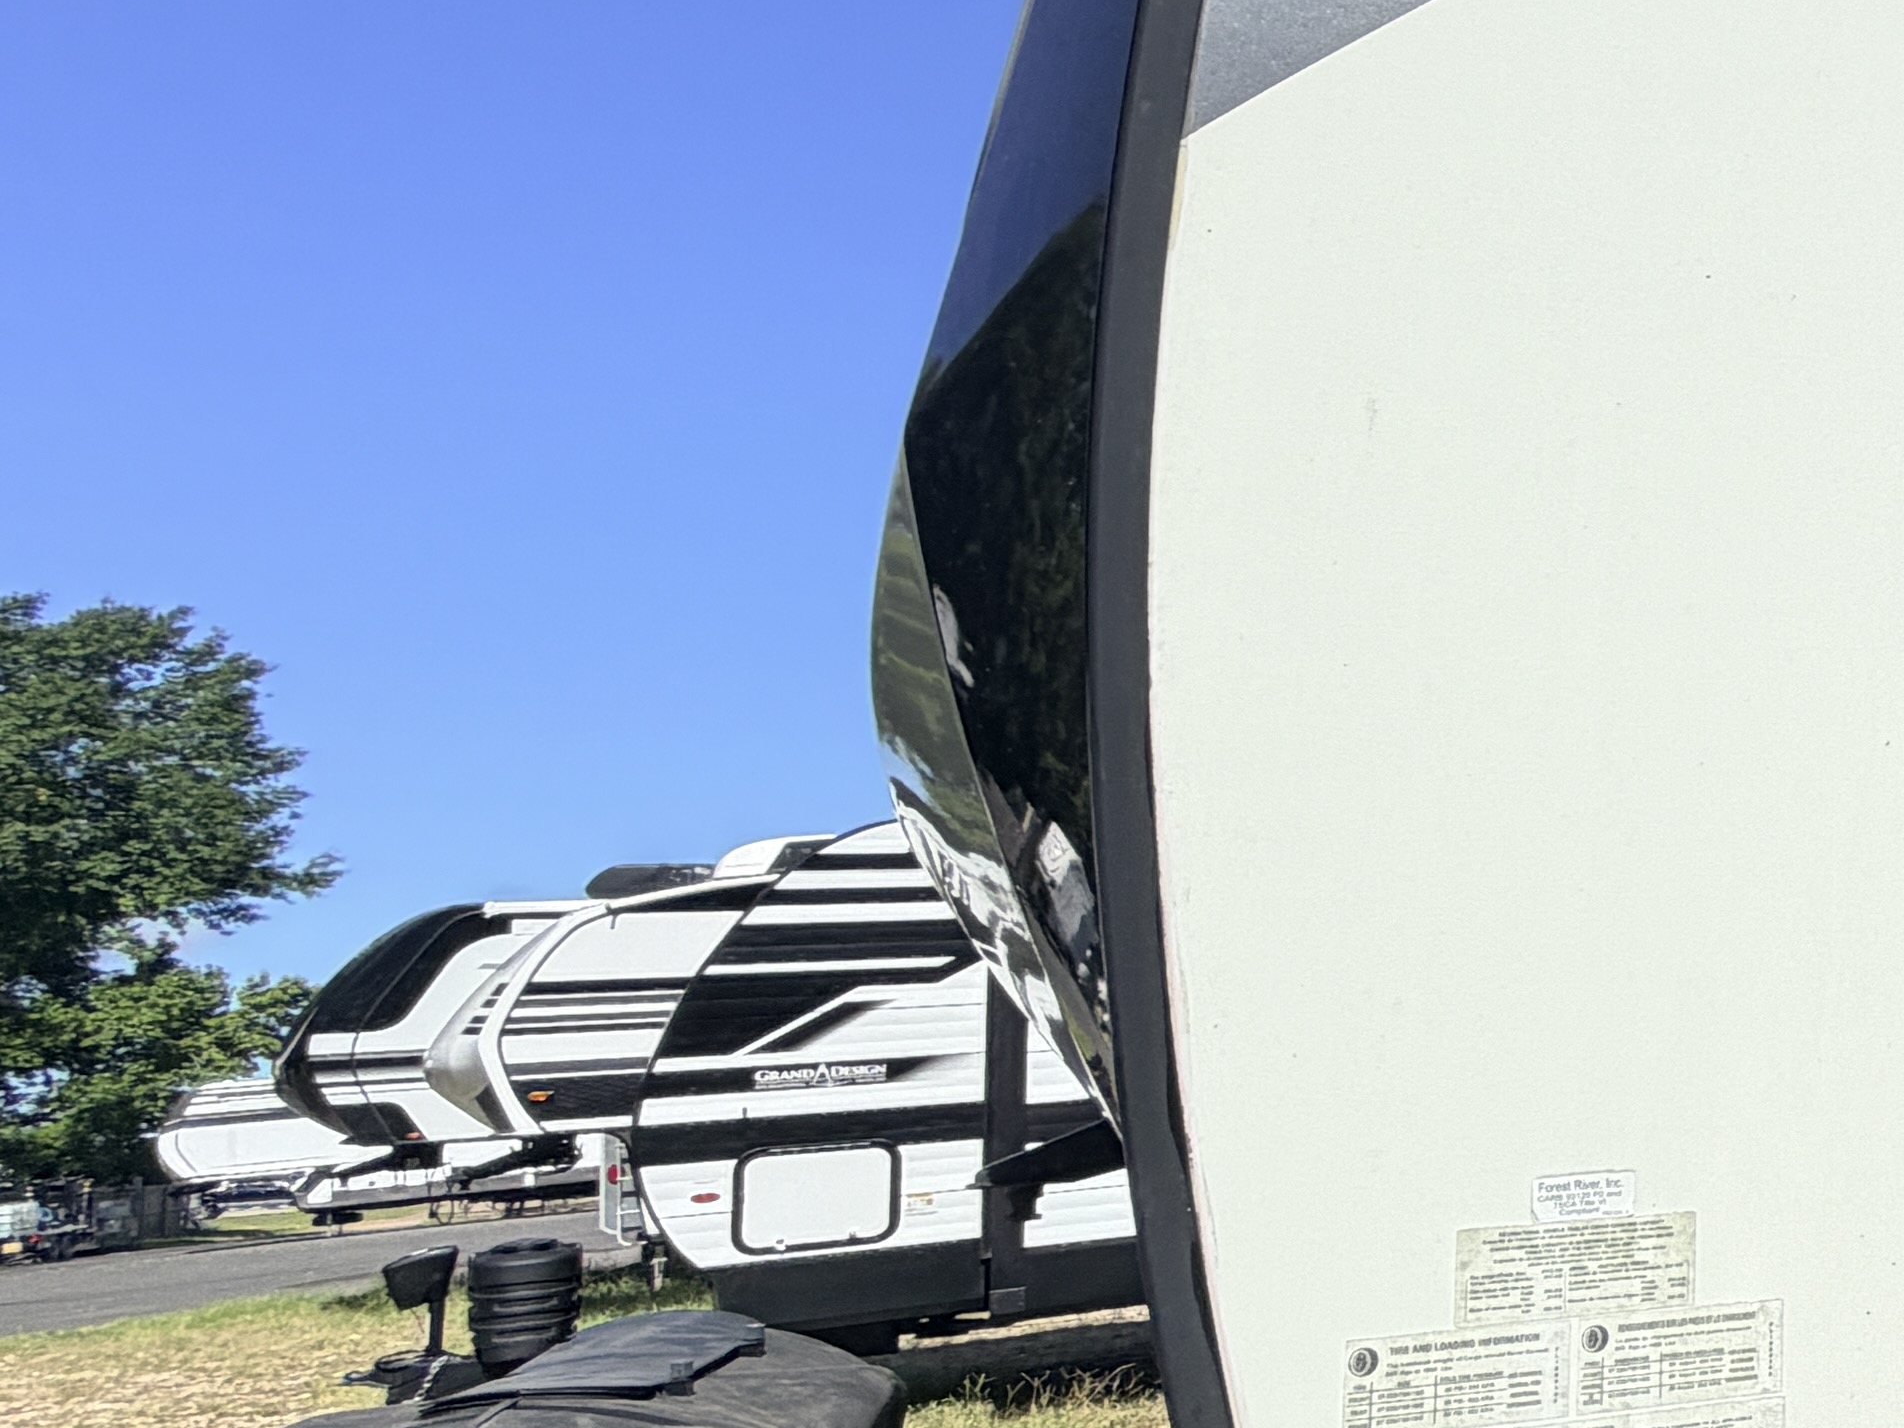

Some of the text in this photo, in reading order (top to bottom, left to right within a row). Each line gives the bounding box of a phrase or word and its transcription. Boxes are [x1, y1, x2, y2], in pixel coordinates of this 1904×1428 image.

[754, 1063, 887, 1081] GRAND DESIGN
[1538, 1181, 1571, 1193] Forest
[1412, 1343, 1433, 1355] AND
[1434, 1339, 1476, 1352] LOADING
[1478, 1332, 1541, 1347] INFORMATION
